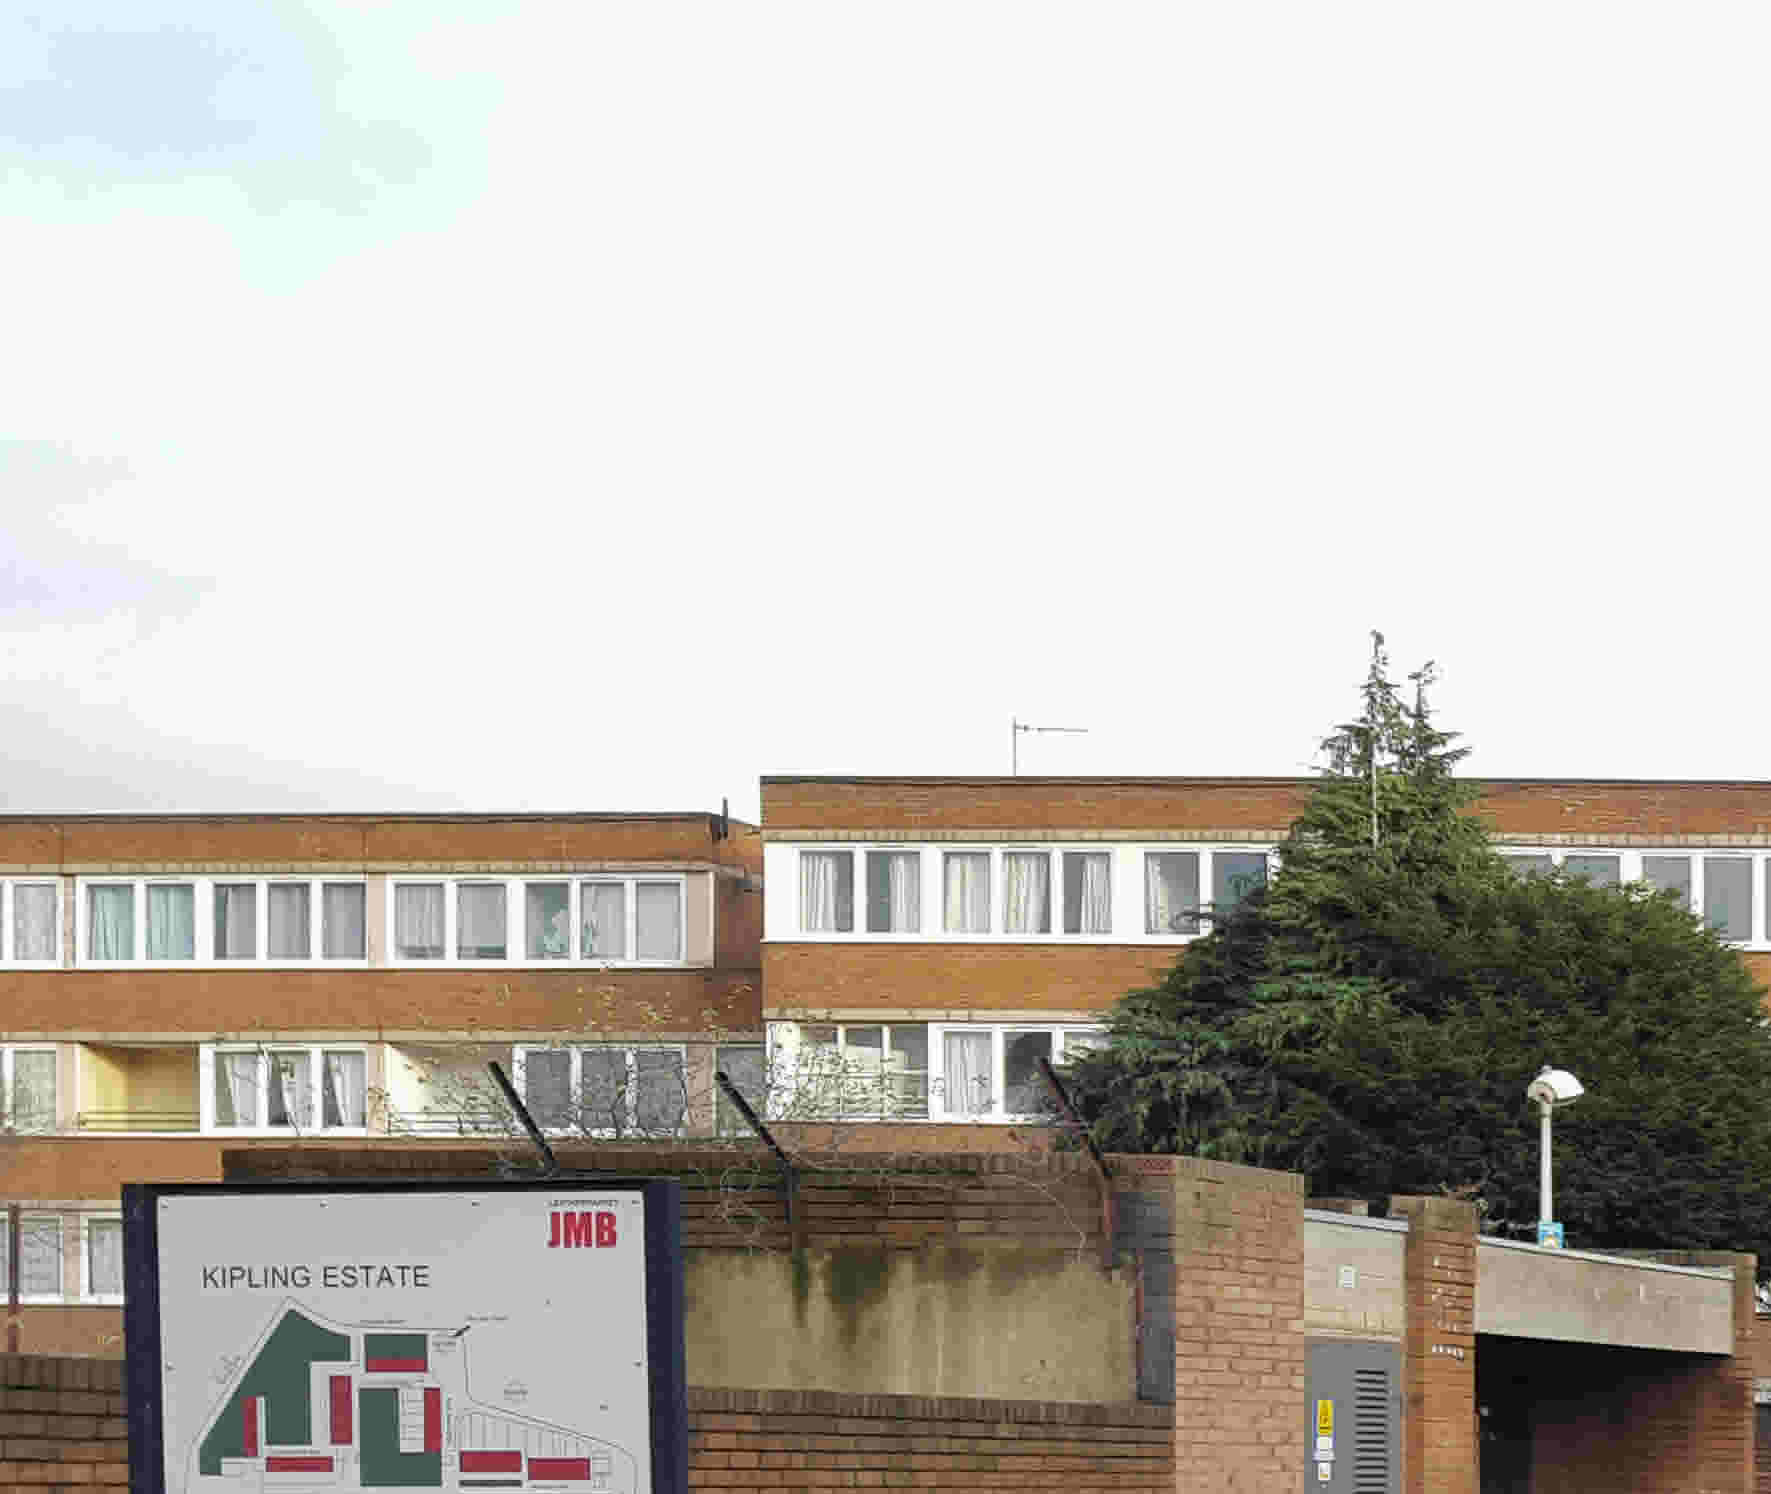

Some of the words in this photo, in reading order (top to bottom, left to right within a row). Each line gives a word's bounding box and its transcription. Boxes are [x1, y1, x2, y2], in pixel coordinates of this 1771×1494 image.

[547, 1210, 618, 1248] JMB
[202, 1264, 312, 1289] KIPLING
[322, 1264, 431, 1289] ESTATE
